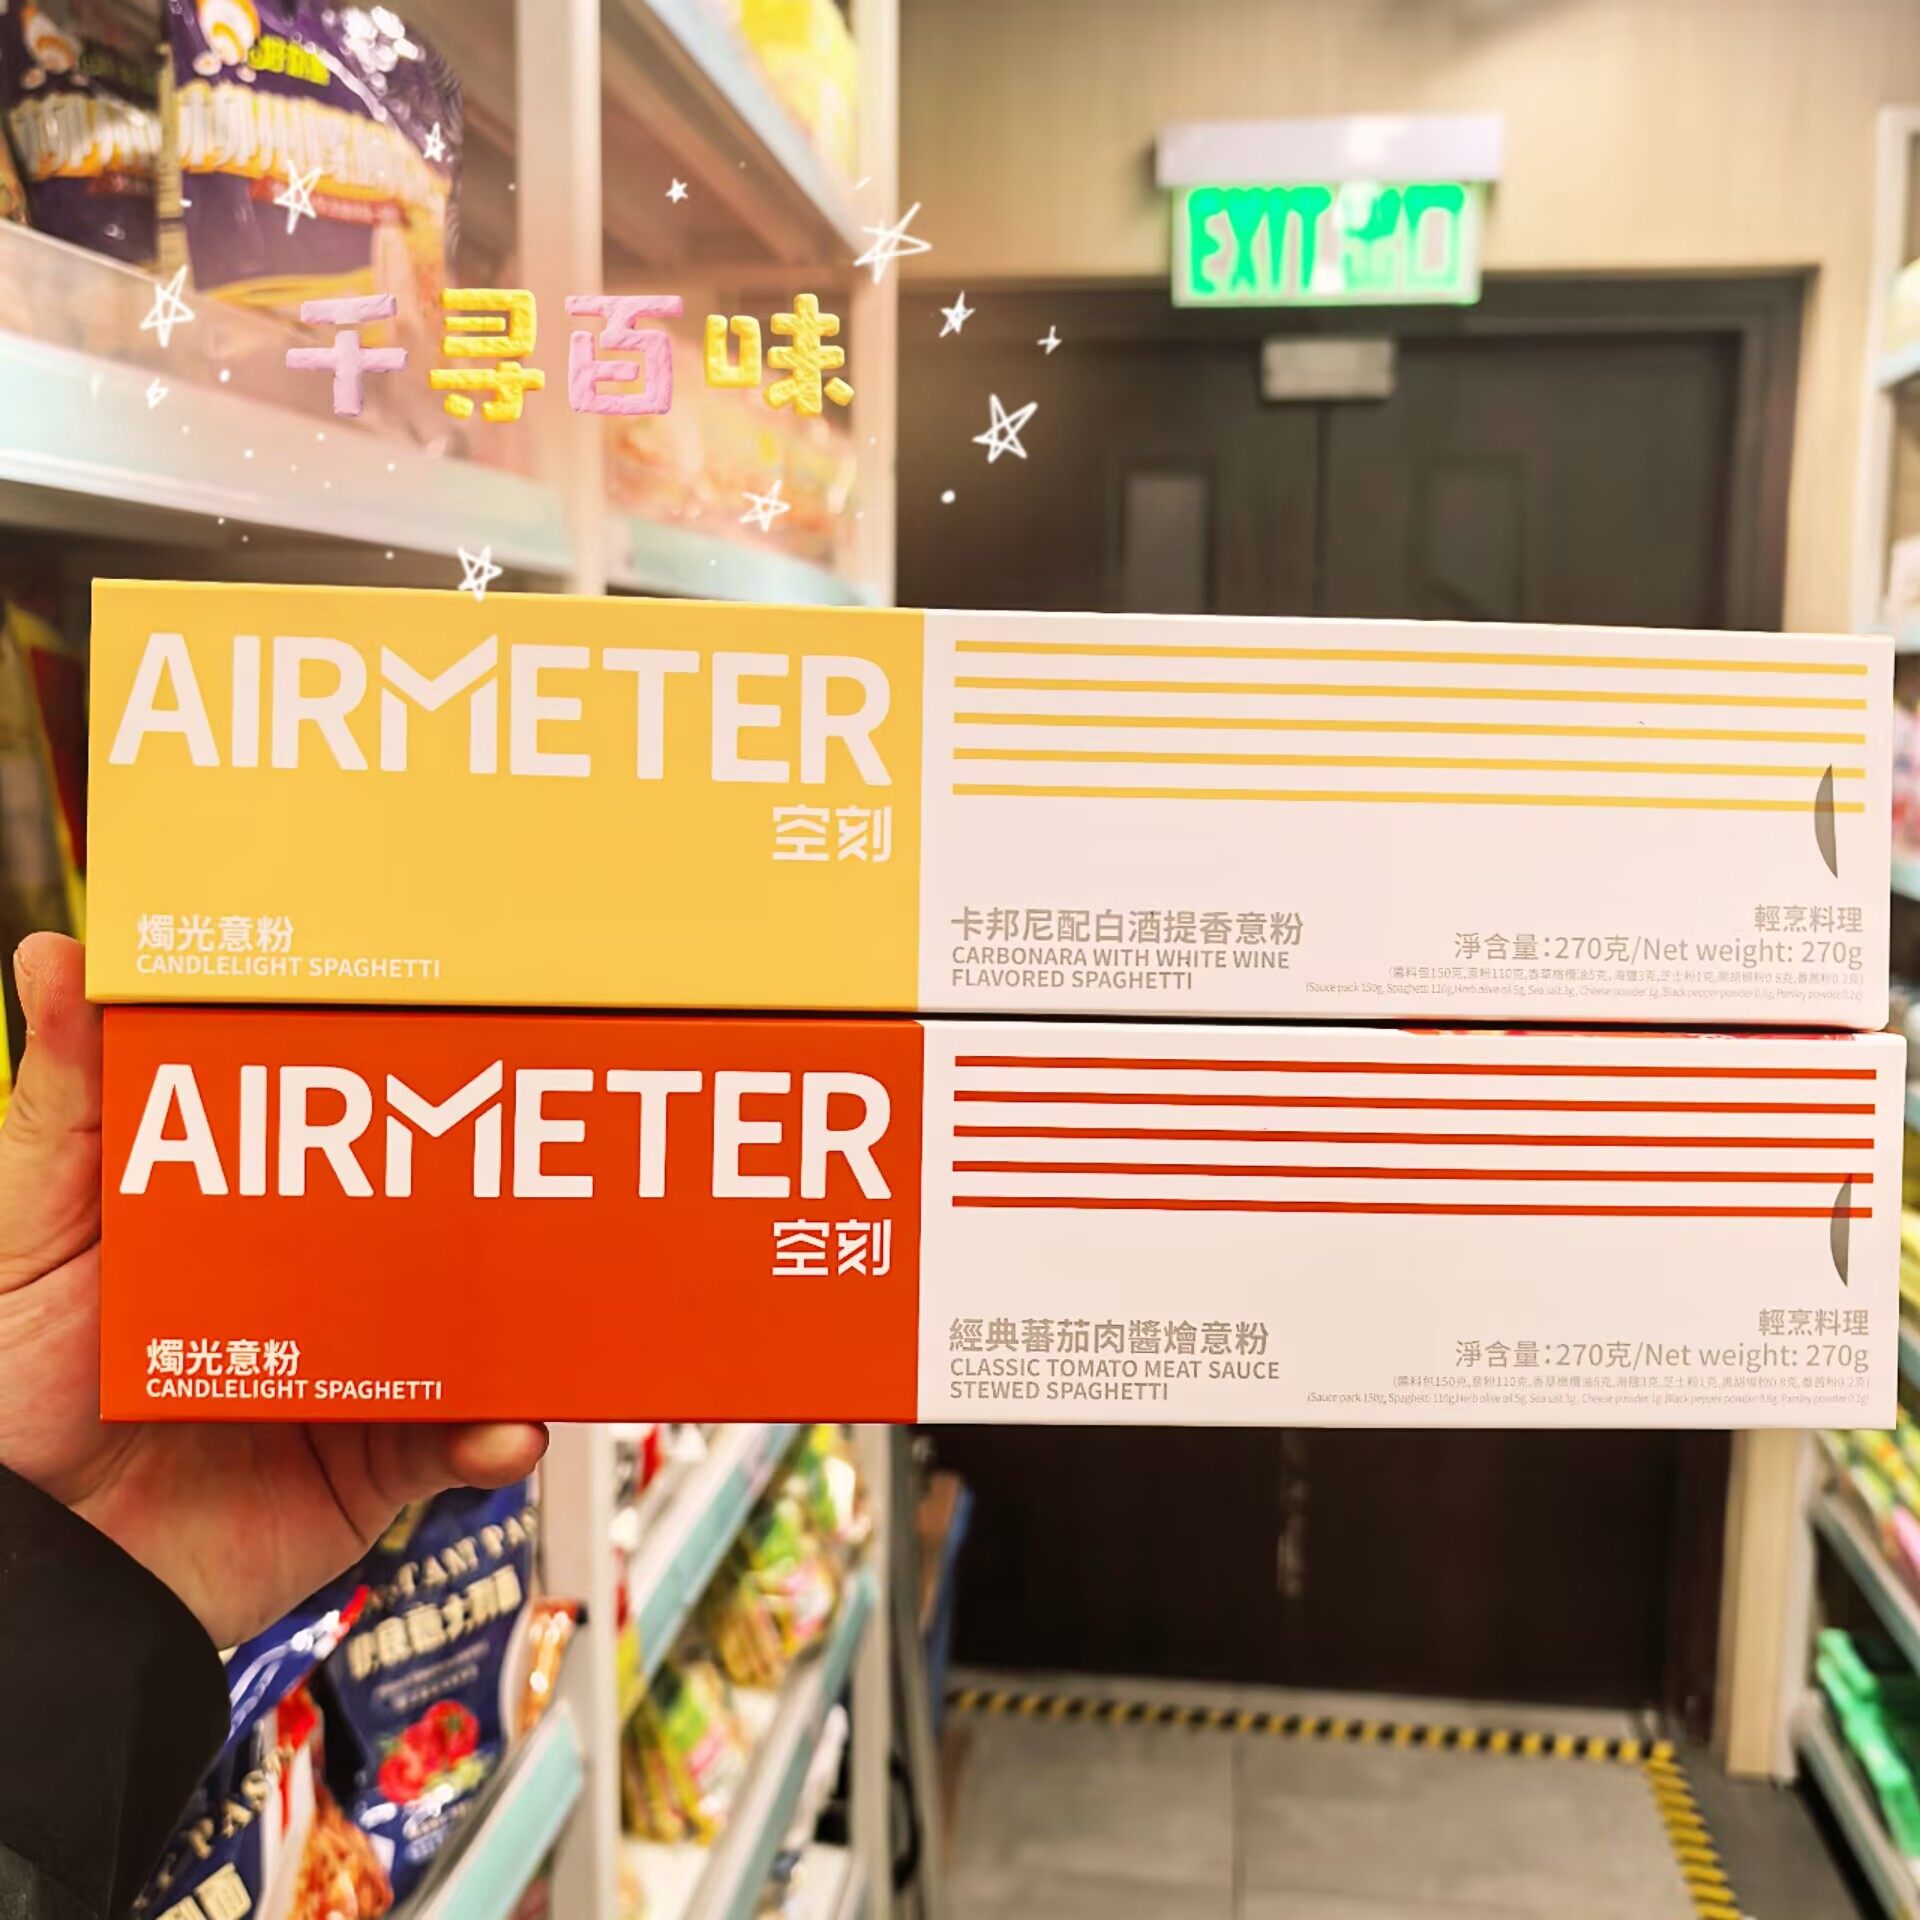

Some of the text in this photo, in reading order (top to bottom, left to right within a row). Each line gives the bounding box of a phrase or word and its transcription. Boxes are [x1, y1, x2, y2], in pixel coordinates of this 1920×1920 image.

[1187, 185, 1331, 295] EXIT
[108, 632, 892, 786] AIRMETER
[772, 803, 893, 863] 空刻
[137, 912, 295, 953] 燭光意粉
[950, 905, 1305, 947] 卡邦尼配白酒提香意粉
[1753, 904, 1864, 934] 輕烹料理
[136, 952, 441, 981] CANDLELIGHT SPAGHETTI
[951, 946, 1291, 970] CARBONARA WITH WHITE WINE
[1695, 938, 1794, 969] weight:
[1800, 940, 1863, 971] 270g
[951, 968, 1193, 991] FLAVORED SPAGHETTI
[119, 1059, 892, 1200] AIRMETER
[772, 1218, 893, 1277] 空刻
[949, 1317, 1269, 1356] 經典蕃茄肉醬燴意粉
[1758, 1308, 1870, 1338] 輕烹料理
[146, 1338, 301, 1377] 燭光意粉
[950, 1357, 1281, 1381] CLASSIC TOMATO MEAT SAUCE
[1698, 1341, 1799, 1373] weight:
[1805, 1343, 1870, 1374] 270g
[145, 1378, 442, 1402] CANDLELIGHT SPAGHETTI
[949, 1380, 1169, 1402] STEWED SPAGHETTI
